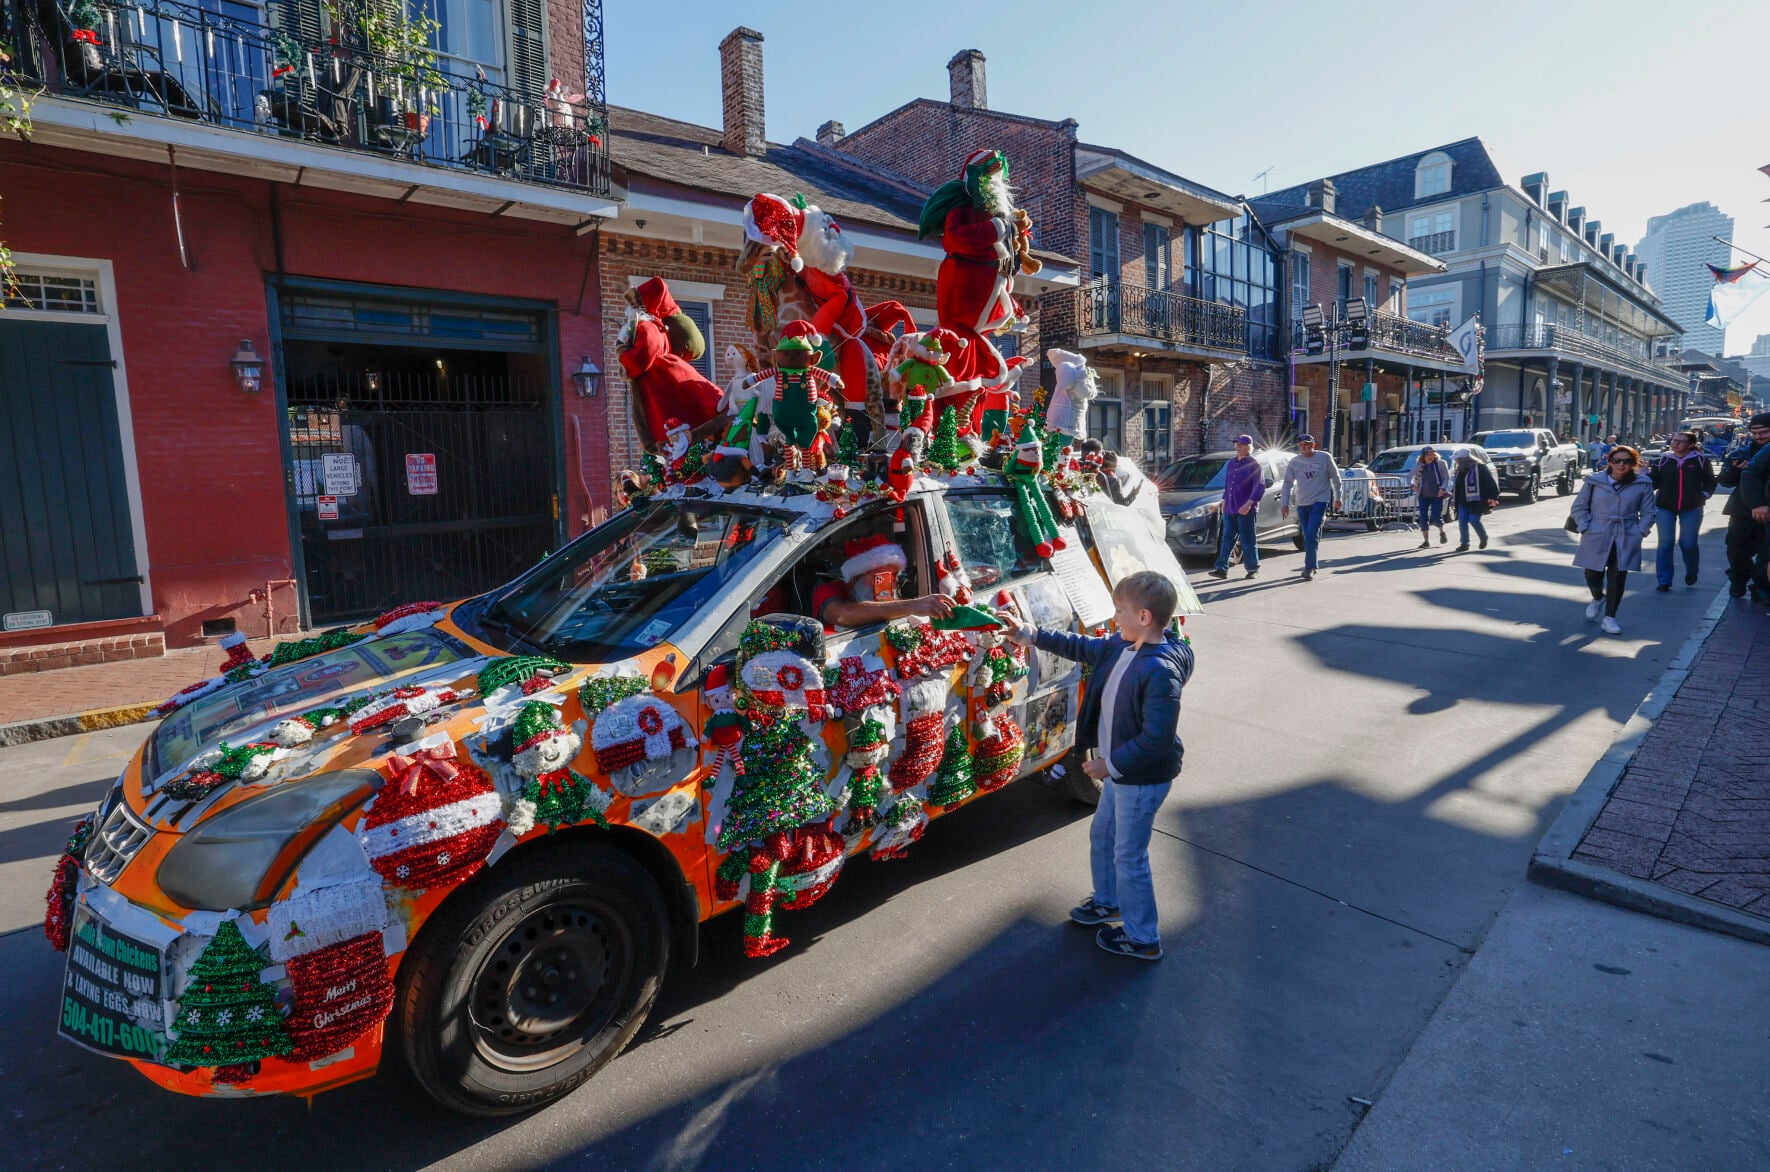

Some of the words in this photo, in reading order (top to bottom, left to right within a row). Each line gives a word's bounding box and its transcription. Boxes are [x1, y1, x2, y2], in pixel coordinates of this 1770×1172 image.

[1304, 471, 1316, 479] W
[72, 944, 119, 985] AVAILABLE
[123, 970, 155, 995] NOW
[116, 938, 158, 972] Chickens
[67, 970, 73, 987] &
[75, 974, 100, 1005] LAYING
[103, 989, 129, 1015] EGGS
[133, 999, 162, 1021] NOW
[323, 979, 356, 1002] Merry
[63, 996, 166, 1056] 504-417-600
[313, 995, 372, 1029] Christmas
